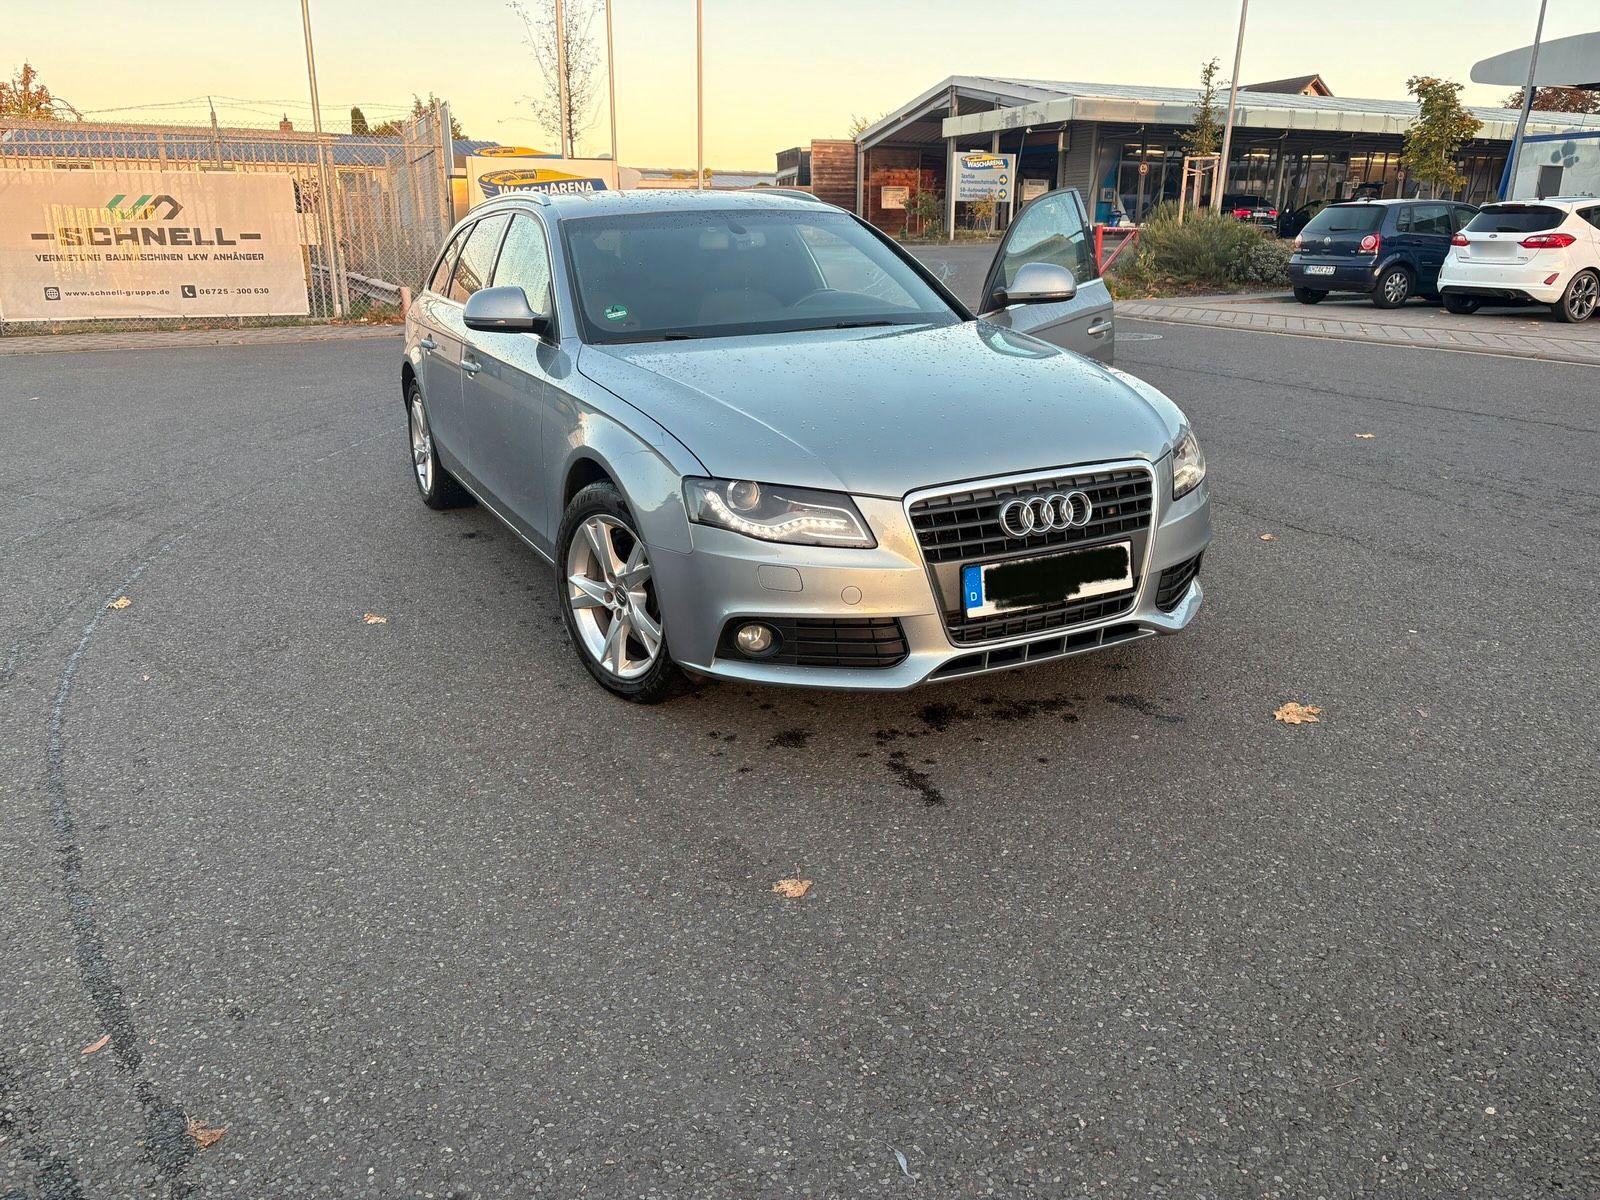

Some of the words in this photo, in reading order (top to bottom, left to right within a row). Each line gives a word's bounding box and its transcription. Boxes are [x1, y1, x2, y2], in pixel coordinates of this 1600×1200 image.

[59, 227, 236, 246] SCHNELL
[105, 253, 183, 261] BAUMASCHINEN
[213, 251, 265, 260] ANHÄNGER
[65, 289, 170, 297] www.schnell-gruppe.de
[236, 287, 252, 295] 300
[970, 592, 978, 602] D
